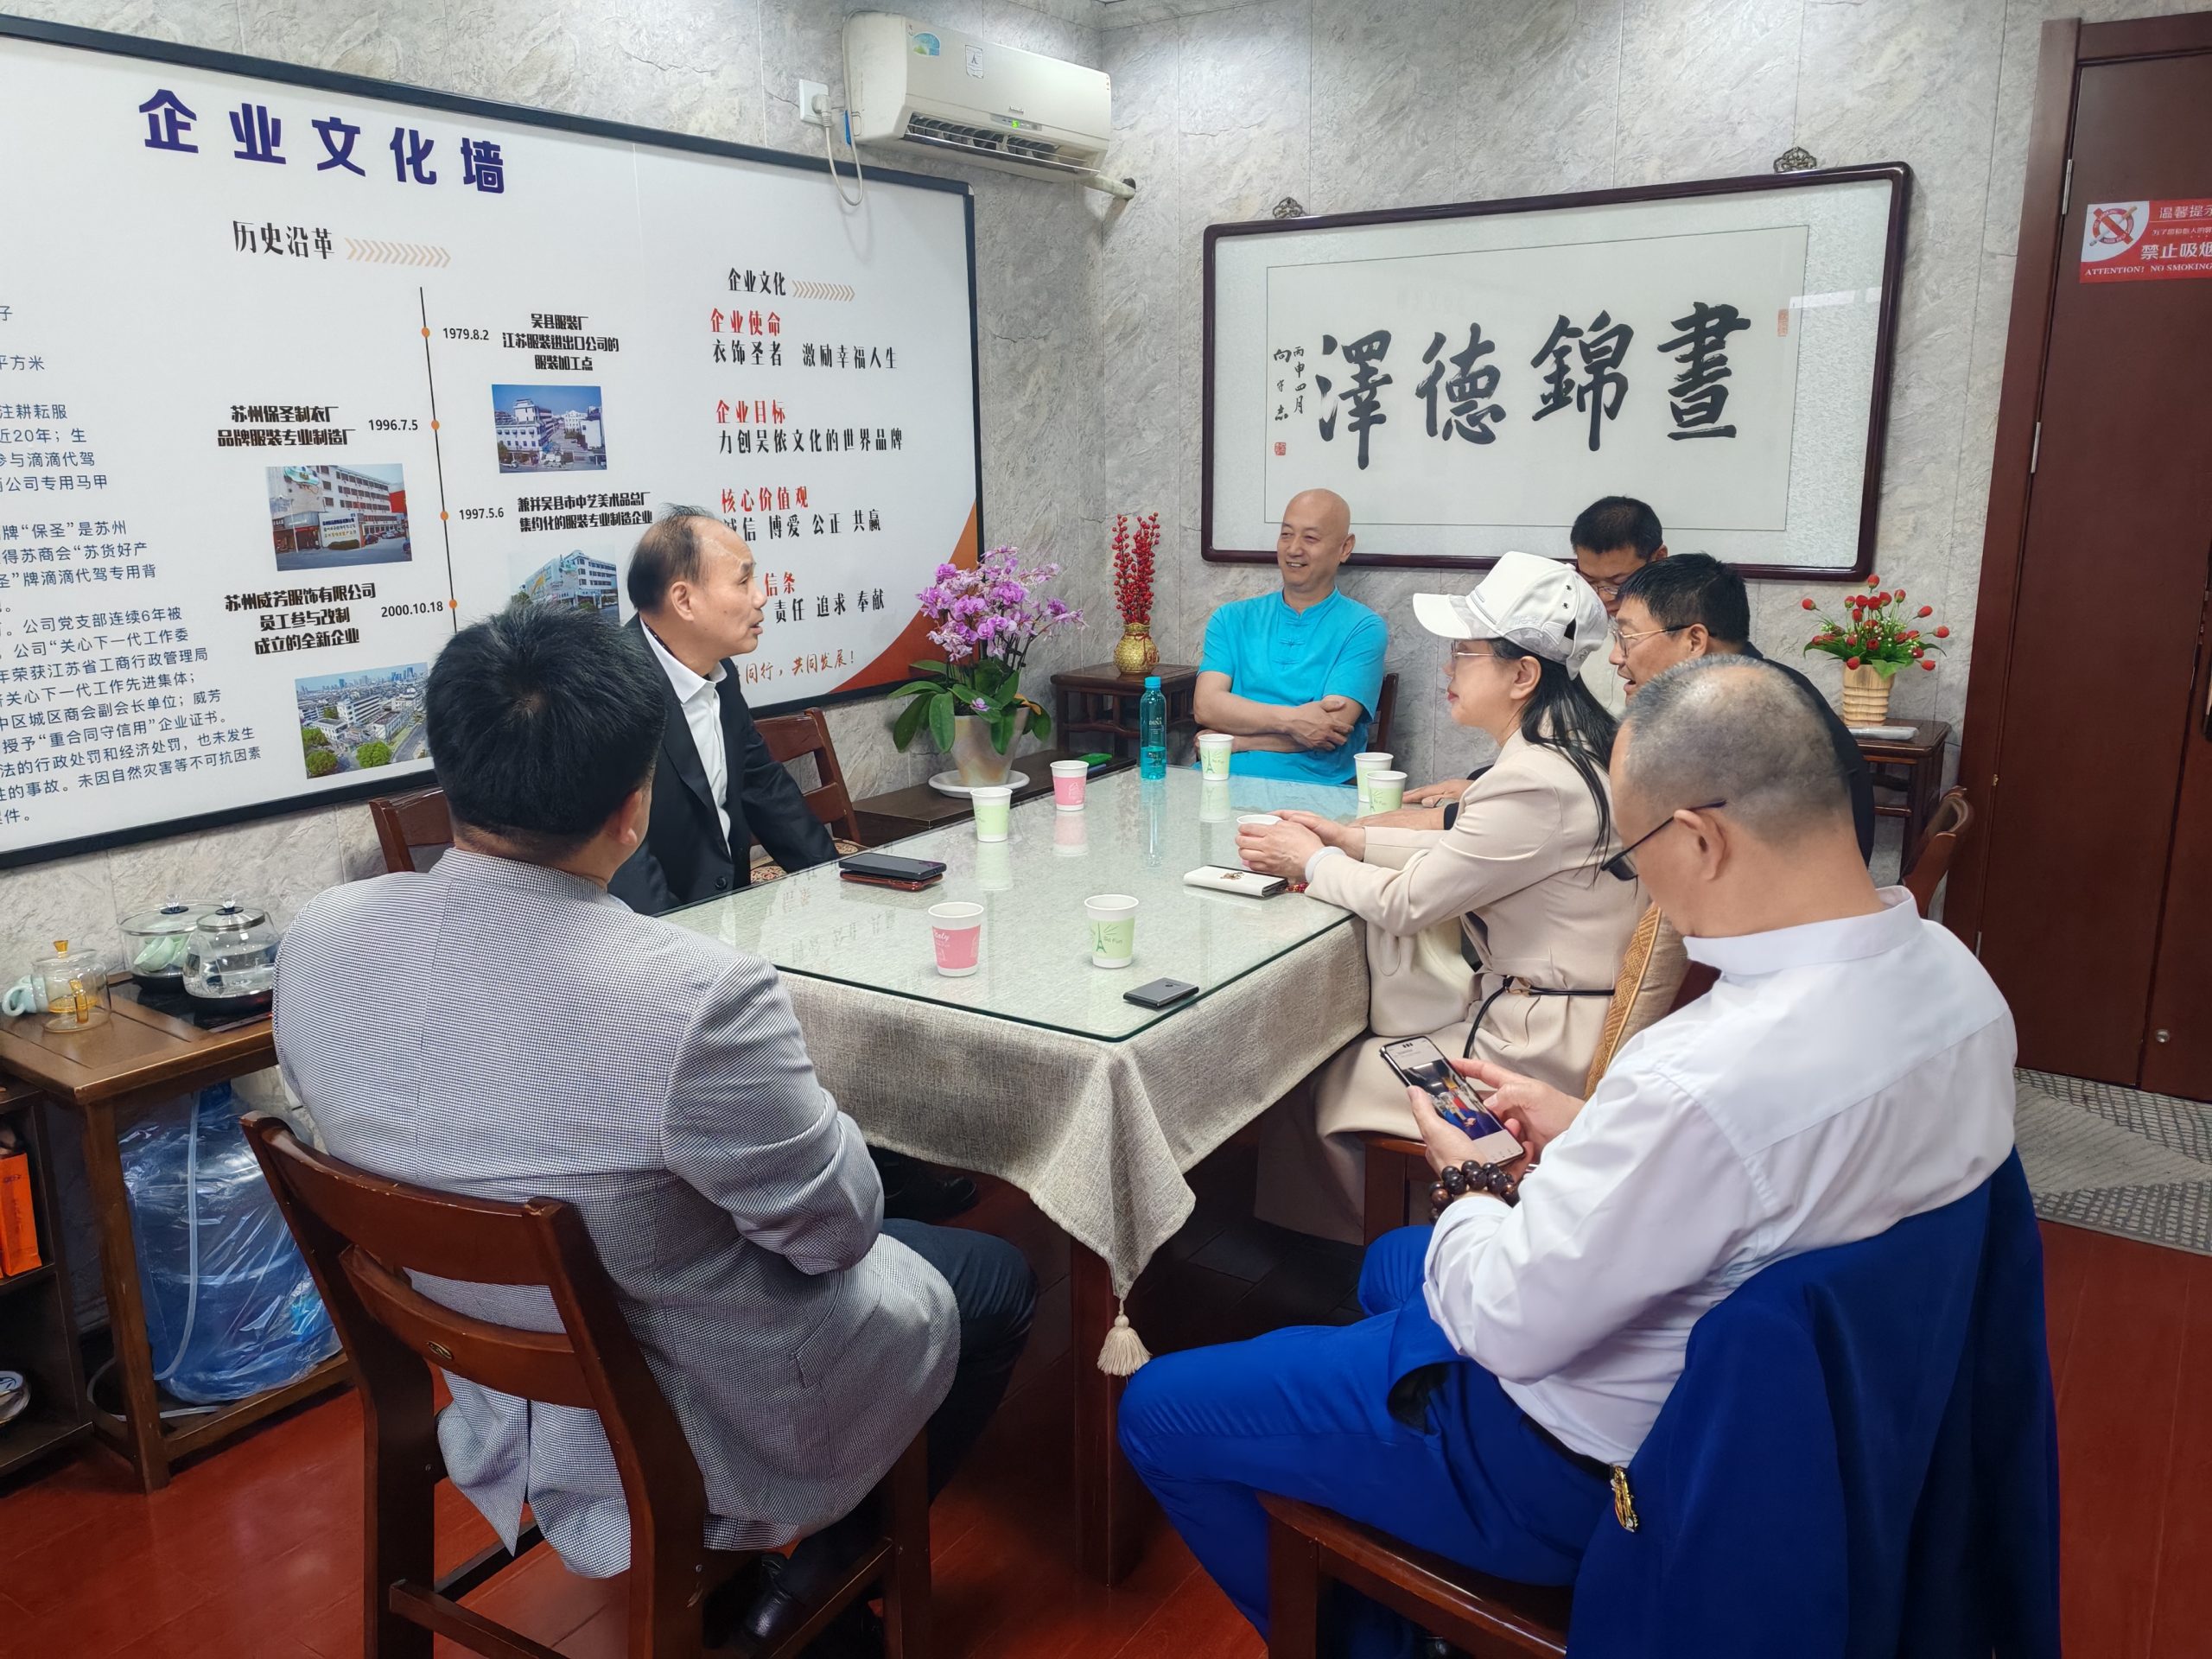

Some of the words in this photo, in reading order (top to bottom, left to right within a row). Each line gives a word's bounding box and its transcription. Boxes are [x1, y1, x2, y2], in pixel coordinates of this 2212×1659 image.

[138, 88, 505, 194] 企业文化墙
[232, 220, 334, 259] 历史沿革
[2141, 242, 2212, 259] 禁止吸烟
[2151, 264, 2164, 273] NO
[728, 267, 786, 296] 企业文化
[442, 327, 489, 340] 1979.8.2
[531, 313, 588, 330] 吴县服装厂
[710, 308, 781, 336] 企业使命
[502, 332, 620, 352] 江苏服装进出口公司的
[712, 339, 782, 366] 衣饰圣者
[802, 342, 898, 369] 激励幸福人生
[535, 355, 593, 371] 服装加工点
[230, 405, 339, 423] 苏州保圣制衣厂
[716, 399, 785, 423] 企业目标
[368, 419, 418, 430] 1996.7.5
[218, 429, 356, 447] 品牌服装专业制造厂
[0, 474, 107, 492] 公司专用马甲
[721, 486, 809, 513] 核心价值观
[459, 507, 504, 520] 1997.5.6
[519, 510, 653, 532] 集约化的服装专业制造企业
[769, 513, 800, 539] 博爱
[812, 512, 842, 535] 公正
[852, 509, 881, 533] 共赢
[753, 571, 795, 596] 信条
[225, 582, 376, 612] 苏州威芳服饰有限公司
[774, 599, 805, 623] 责任
[816, 593, 846, 618] 追求
[856, 588, 884, 613] 奉献
[260, 607, 350, 632] 员工参与改制
[381, 601, 443, 618] 2000.10.18
[0, 607, 182, 638] 。公司党支部连续6年被
[254, 627, 360, 655] 成立的全新企业
[735, 649, 854, 684] 同行，共同发展！
[0, 671, 195, 708] 关心下一代工作先进集体；
[0, 808, 29, 824] 件。
